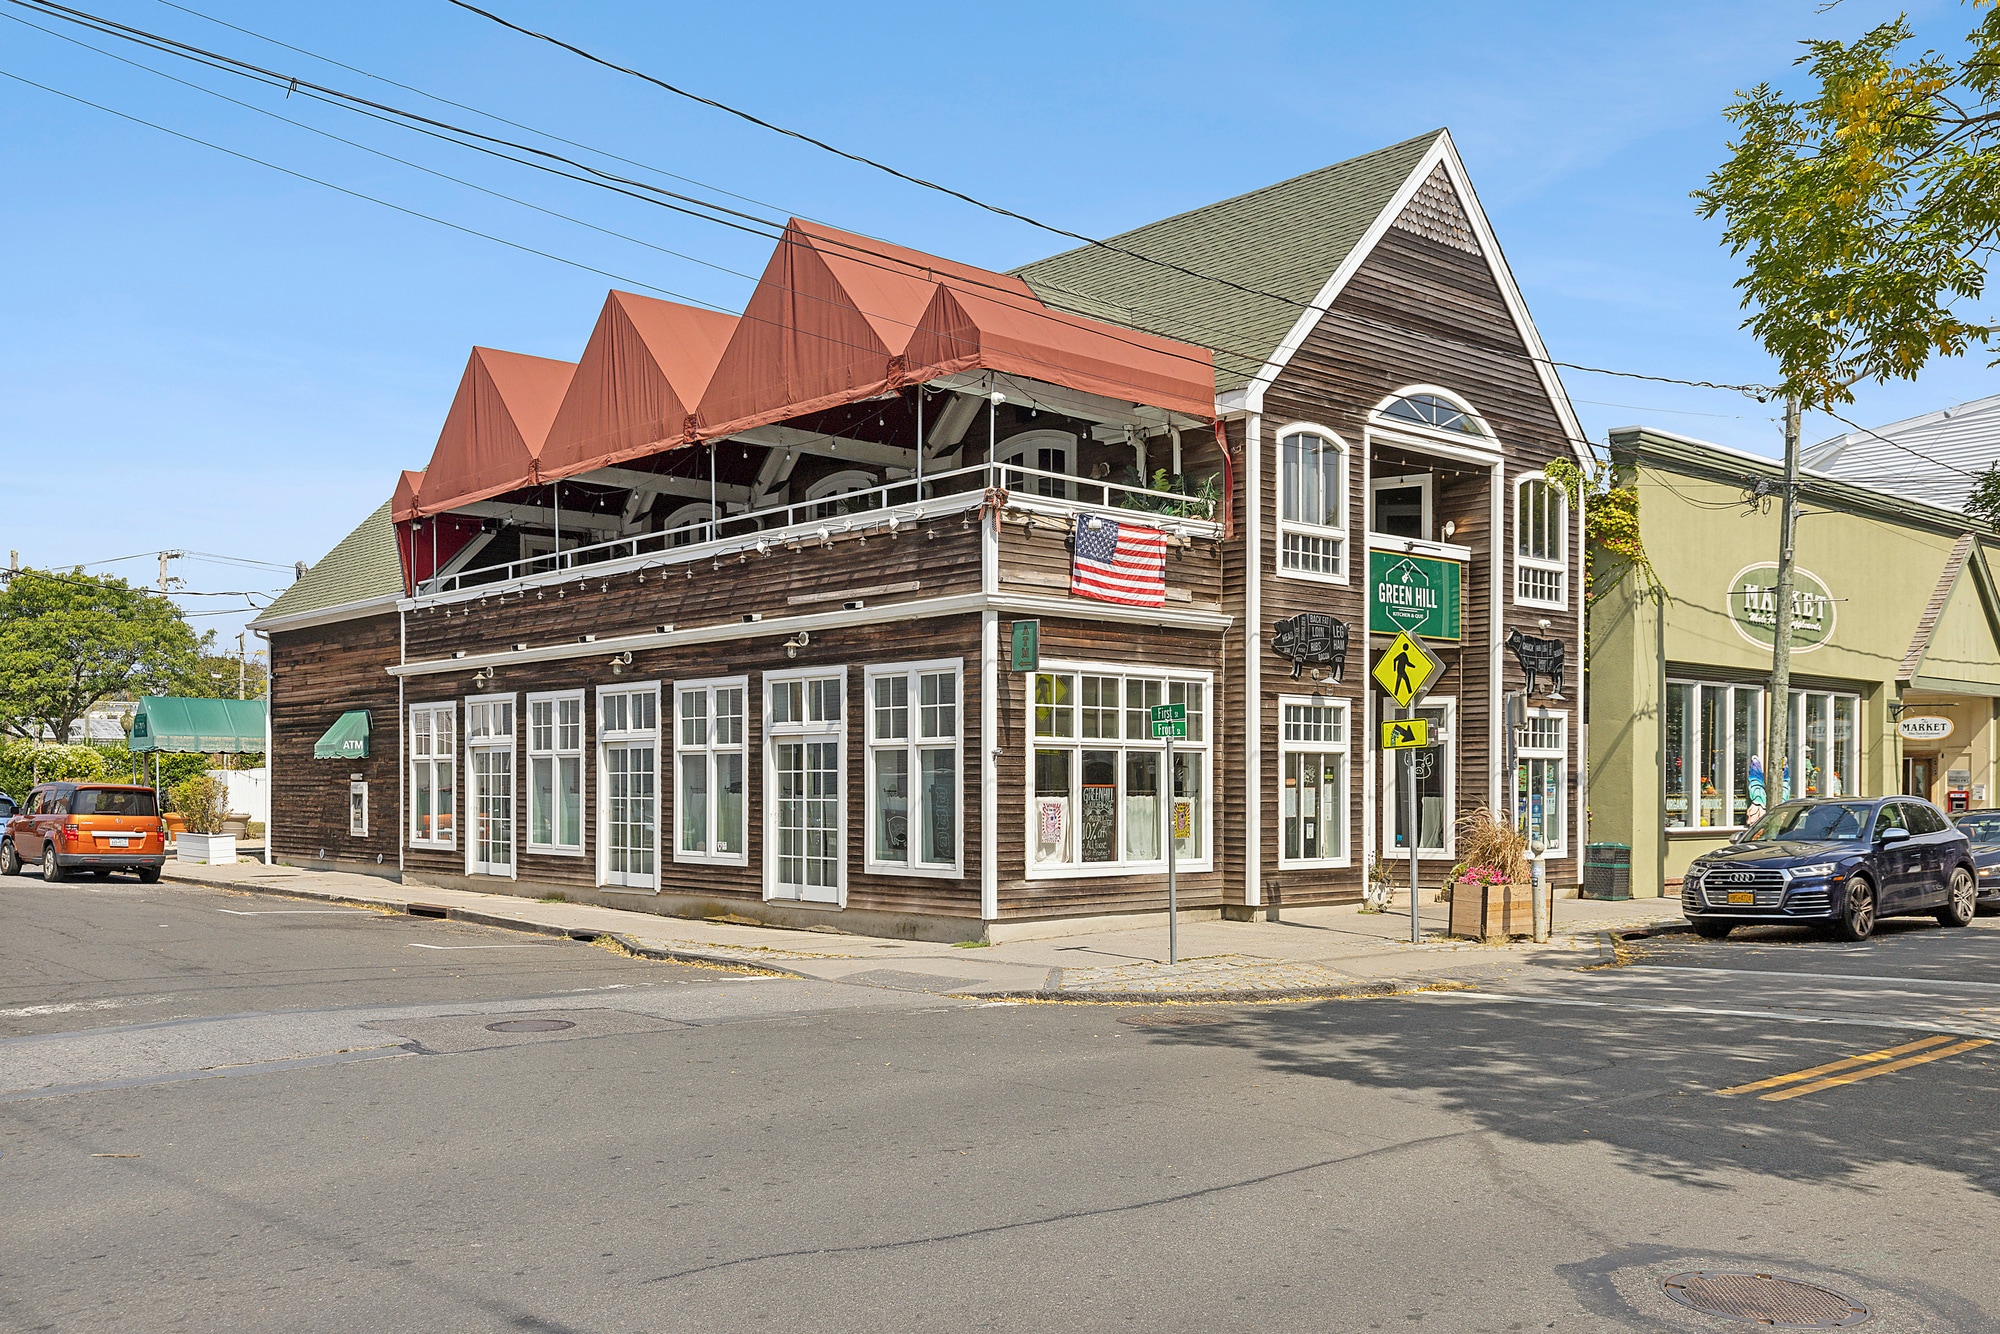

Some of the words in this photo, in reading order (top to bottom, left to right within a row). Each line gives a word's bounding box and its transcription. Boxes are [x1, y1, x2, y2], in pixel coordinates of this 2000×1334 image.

[1379, 583, 1412, 606] GREEN
[1415, 587, 1438, 609] HILL
[1743, 583, 1826, 618] MAKET
[1309, 614, 1321, 625] BACK
[1321, 616, 1330, 626] FAT
[1311, 626, 1325, 638] LOIN
[1332, 625, 1345, 639] LEG
[1791, 620, 1822, 633] upplements
[1021, 624, 1030, 659] ATM
[1281, 631, 1294, 643] HEAD
[1310, 642, 1322, 652] RIBS
[1333, 640, 1345, 651] HAM
[1317, 652, 1330, 661] BACON
[1157, 707, 1172, 719] First
[1157, 723, 1175, 736] Front
[1902, 723, 1947, 732] MARKET
[343, 740, 364, 750] ATM
[1666, 798, 1689, 811] ORGANIC
[1700, 798, 1723, 810] PRODUCE
[1082, 821, 1098, 840] 10%
